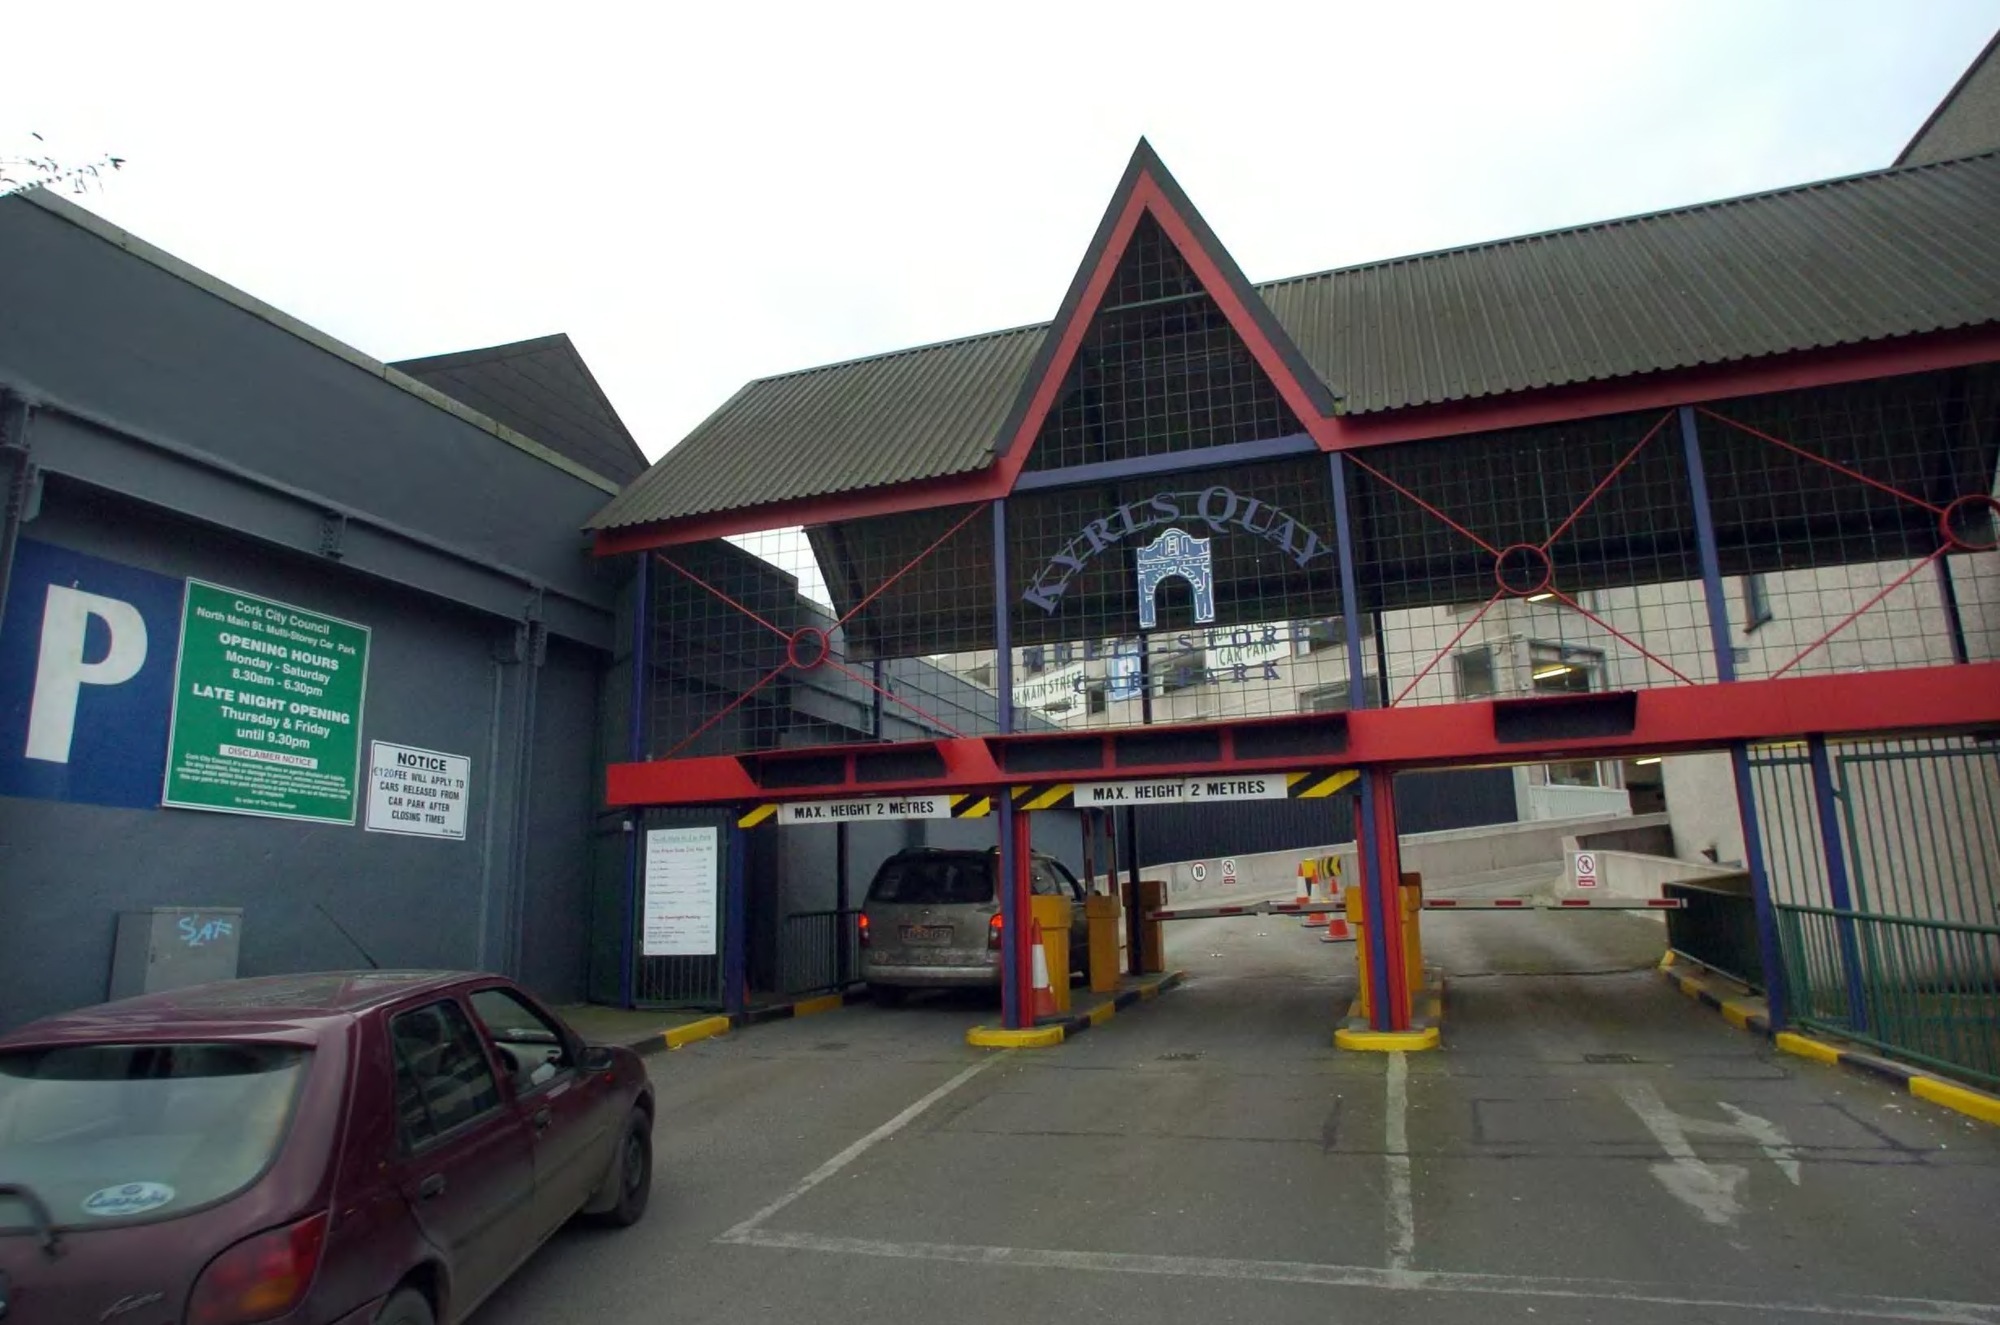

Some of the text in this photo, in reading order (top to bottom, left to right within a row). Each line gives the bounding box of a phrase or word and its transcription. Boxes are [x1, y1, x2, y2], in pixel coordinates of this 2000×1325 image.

[1197, 486, 1333, 568] QUAY
[235, 600, 329, 635] Cork City Council
[197, 607, 225, 622] North
[227, 615, 249, 628] Main
[251, 621, 264, 633] St.
[320, 638, 333, 649] Car
[338, 643, 356, 655] Park
[219, 632, 339, 671] OPENING HOURS
[24, 583, 148, 763] P
[226, 650, 273, 672] Monday
[282, 663, 331, 686] Saturday
[232, 668, 274, 686] 8.30am
[284, 679, 323, 697] 6.30pm
[193, 683, 350, 724] LATE NIGHT OPENING
[221, 705, 331, 739] Thursday & Friday
[237, 728, 310, 749] until 9.30pm
[228, 747, 313, 767] DISCLAIMER NOTICE
[398, 752, 447, 771] NOTICE
[380, 781, 460, 800] CARS RELEASED FROM
[412, 773, 427, 783] WILL
[431, 775, 452, 787] APPLY
[456, 779, 464, 789] TO
[1093, 780, 1266, 800] MAX. HEIGHT 2 METRES
[388, 796, 450, 812] CAR PARK AFTER
[794, 801, 934, 819] MAX. HEIGHT 2 METRES
[392, 810, 445, 825] CLOSING TIMES
[1195, 866, 1204, 878] 10
